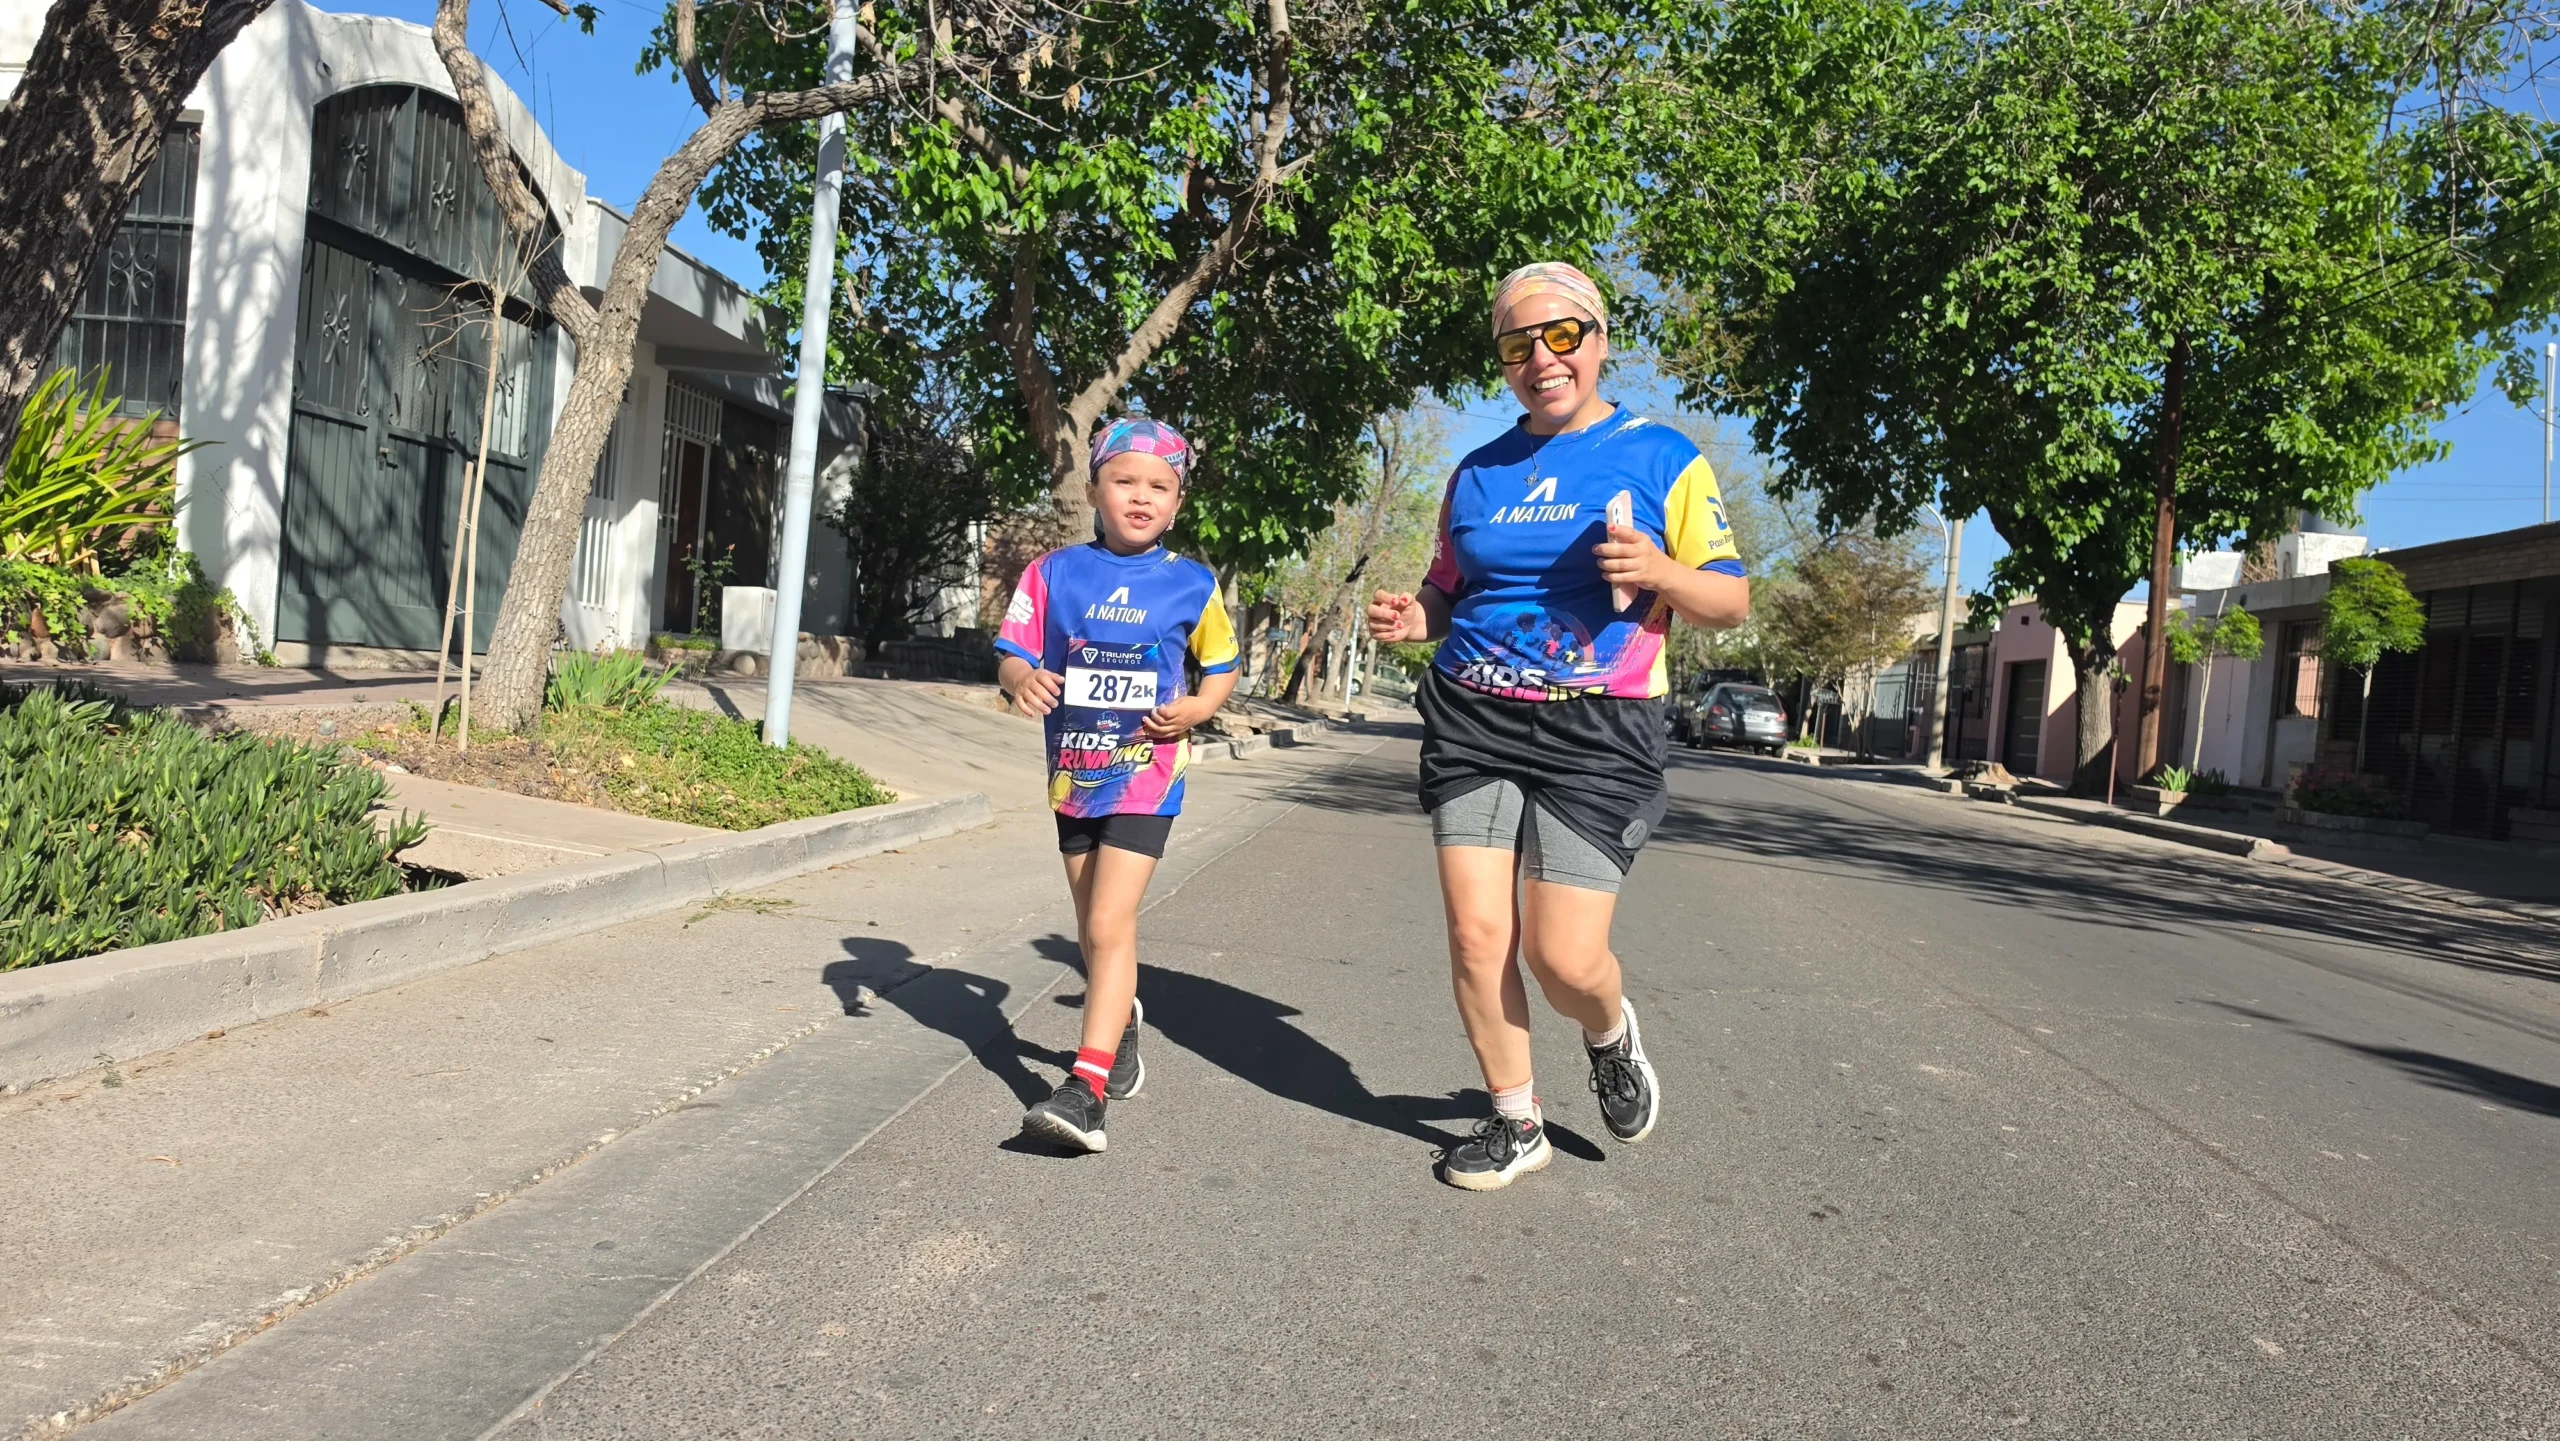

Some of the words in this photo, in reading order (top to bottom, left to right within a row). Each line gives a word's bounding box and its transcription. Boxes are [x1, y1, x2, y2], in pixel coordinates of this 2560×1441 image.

[1489, 506, 1507, 524] A
[1506, 502, 1581, 524] NATION
[1085, 603, 1096, 619] A
[1096, 604, 1148, 625] NATION
[1100, 651, 1143, 660] TRIUNFO
[1101, 657, 1141, 665] SEGUROS
[1461, 663, 1547, 687] KIDS
[1088, 673, 1133, 703] 287
[1060, 732, 1120, 750] KIDS
[1057, 742, 1154, 770] RUNNING
[1073, 761, 1135, 781] DORREGO
